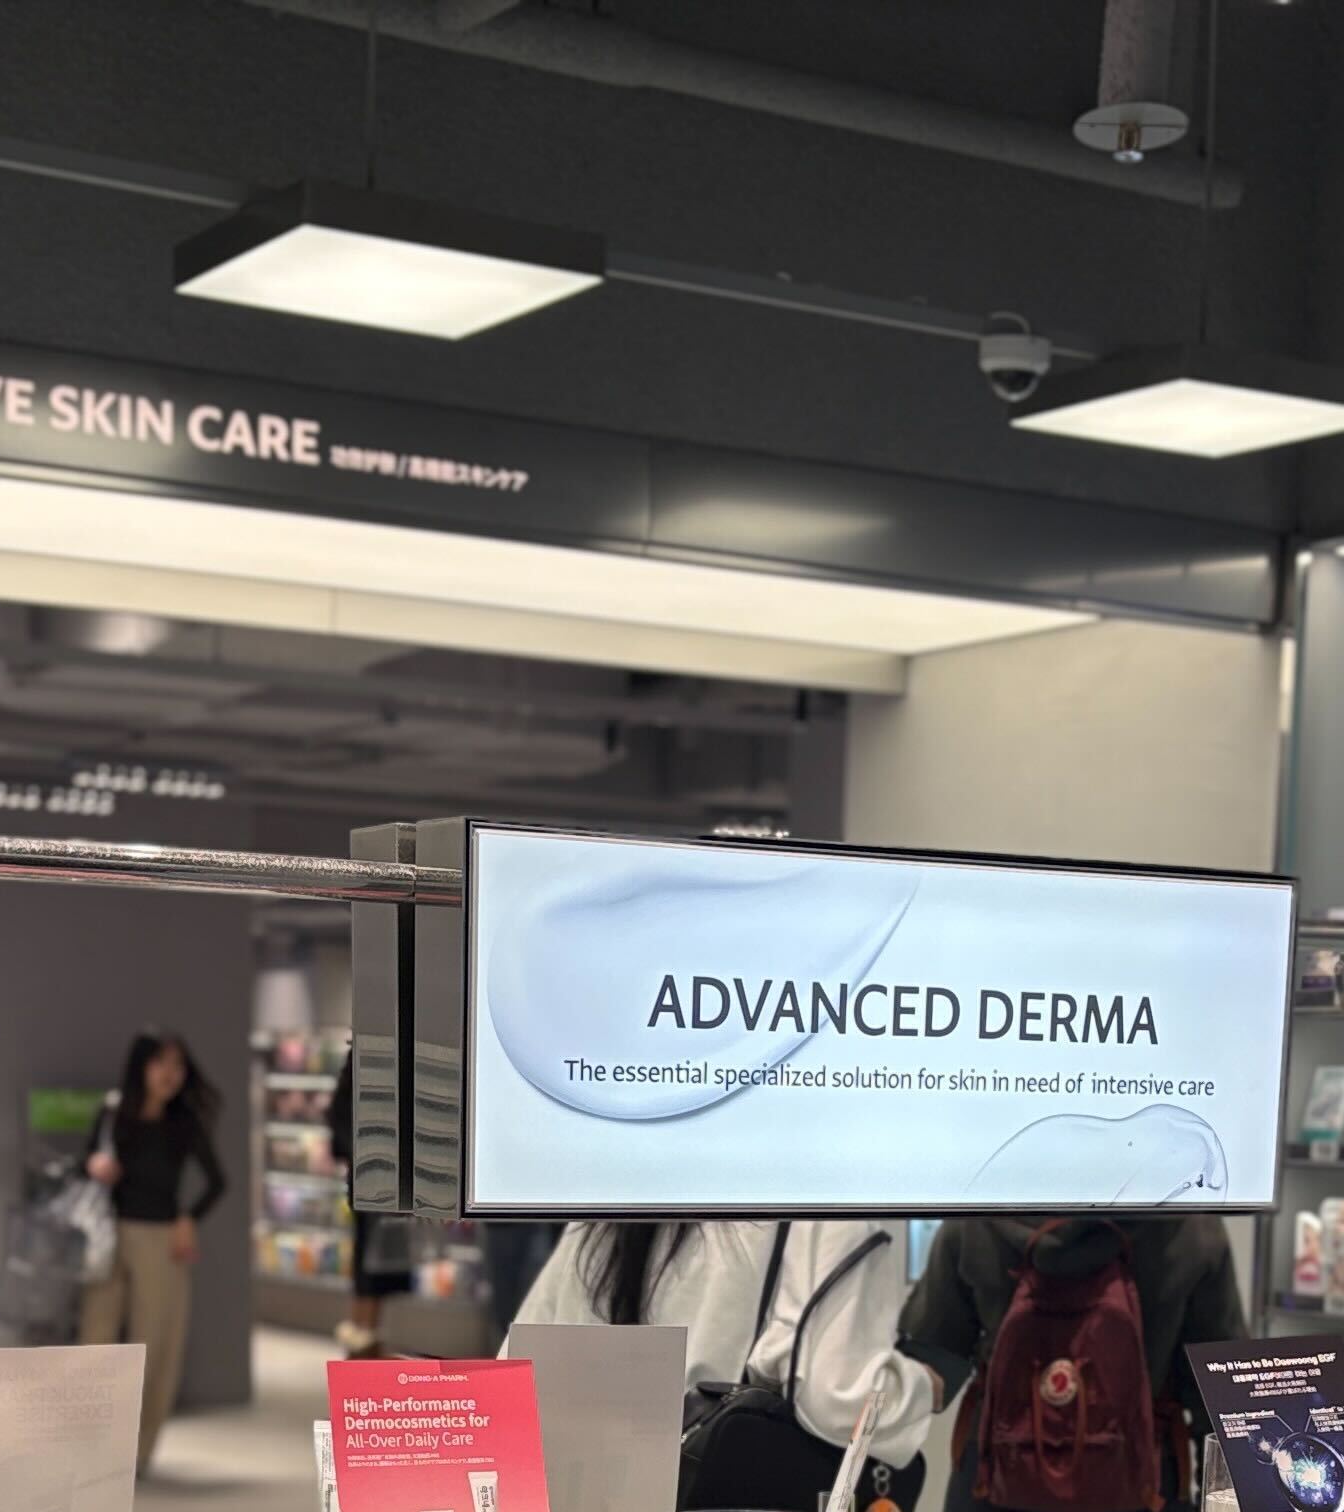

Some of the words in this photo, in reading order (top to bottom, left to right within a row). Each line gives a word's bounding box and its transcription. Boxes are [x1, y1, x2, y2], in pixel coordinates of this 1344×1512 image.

[48, 386, 176, 446] SKIN
[187, 406, 321, 467] CARE
[647, 974, 960, 1038] ADVANCED
[977, 989, 1159, 1045] DERMA
[564, 1059, 606, 1083] The
[612, 1061, 708, 1085] essential
[713, 1063, 826, 1092] specialized
[831, 1065, 912, 1090] solution
[916, 1067, 946, 1091] for
[949, 1069, 988, 1092] skin
[992, 1071, 1009, 1093] in
[1014, 1070, 1060, 1094] need
[1063, 1071, 1086, 1095] of
[1090, 1073, 1174, 1096] intensive
[1178, 1080, 1216, 1097] care
[343, 1397, 477, 1416] High-Performance
[344, 1414, 467, 1431] Dermocosmetics
[468, 1412, 491, 1428] for
[346, 1432, 403, 1449] All-Over
[405, 1432, 439, 1450] Daily
[442, 1431, 474, 1446] Care
